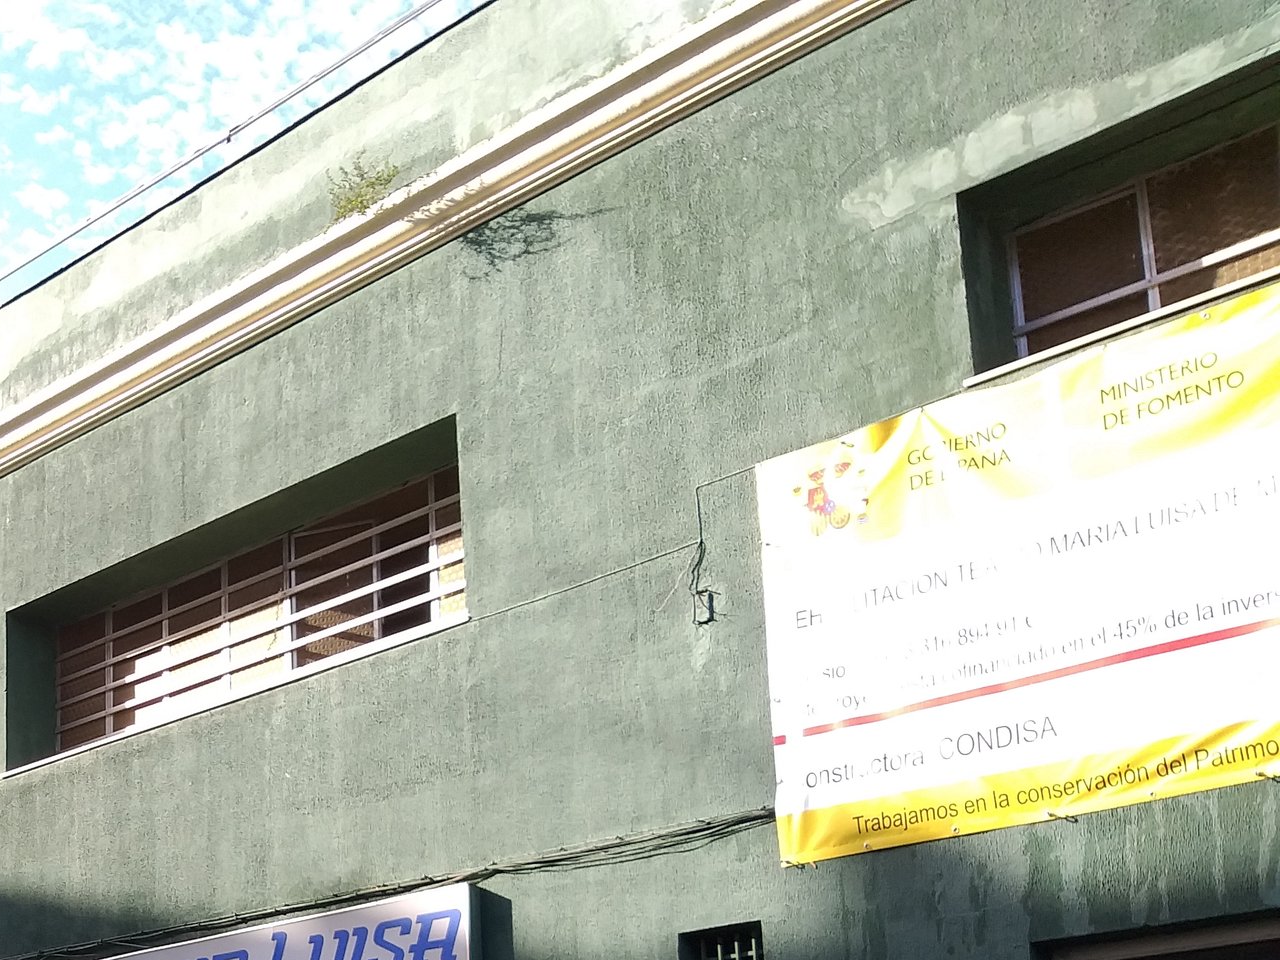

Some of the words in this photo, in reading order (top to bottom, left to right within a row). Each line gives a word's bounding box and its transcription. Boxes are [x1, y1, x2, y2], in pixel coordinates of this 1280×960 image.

[1100, 352, 1218, 405] MINISTERIO
[1103, 406, 1129, 431] DE
[1137, 370, 1245, 420] FOMENTO
[1113, 616, 1157, 640] 45%
[1164, 609, 1189, 629] de
[1196, 602, 1215, 622] la
[939, 716, 1058, 760] CONDISA
[853, 803, 959, 835] Trabajamos
[964, 797, 987, 814] en
[992, 790, 1011, 809] la
[1017, 763, 1149, 805] conservación
[1156, 753, 1188, 778] del
